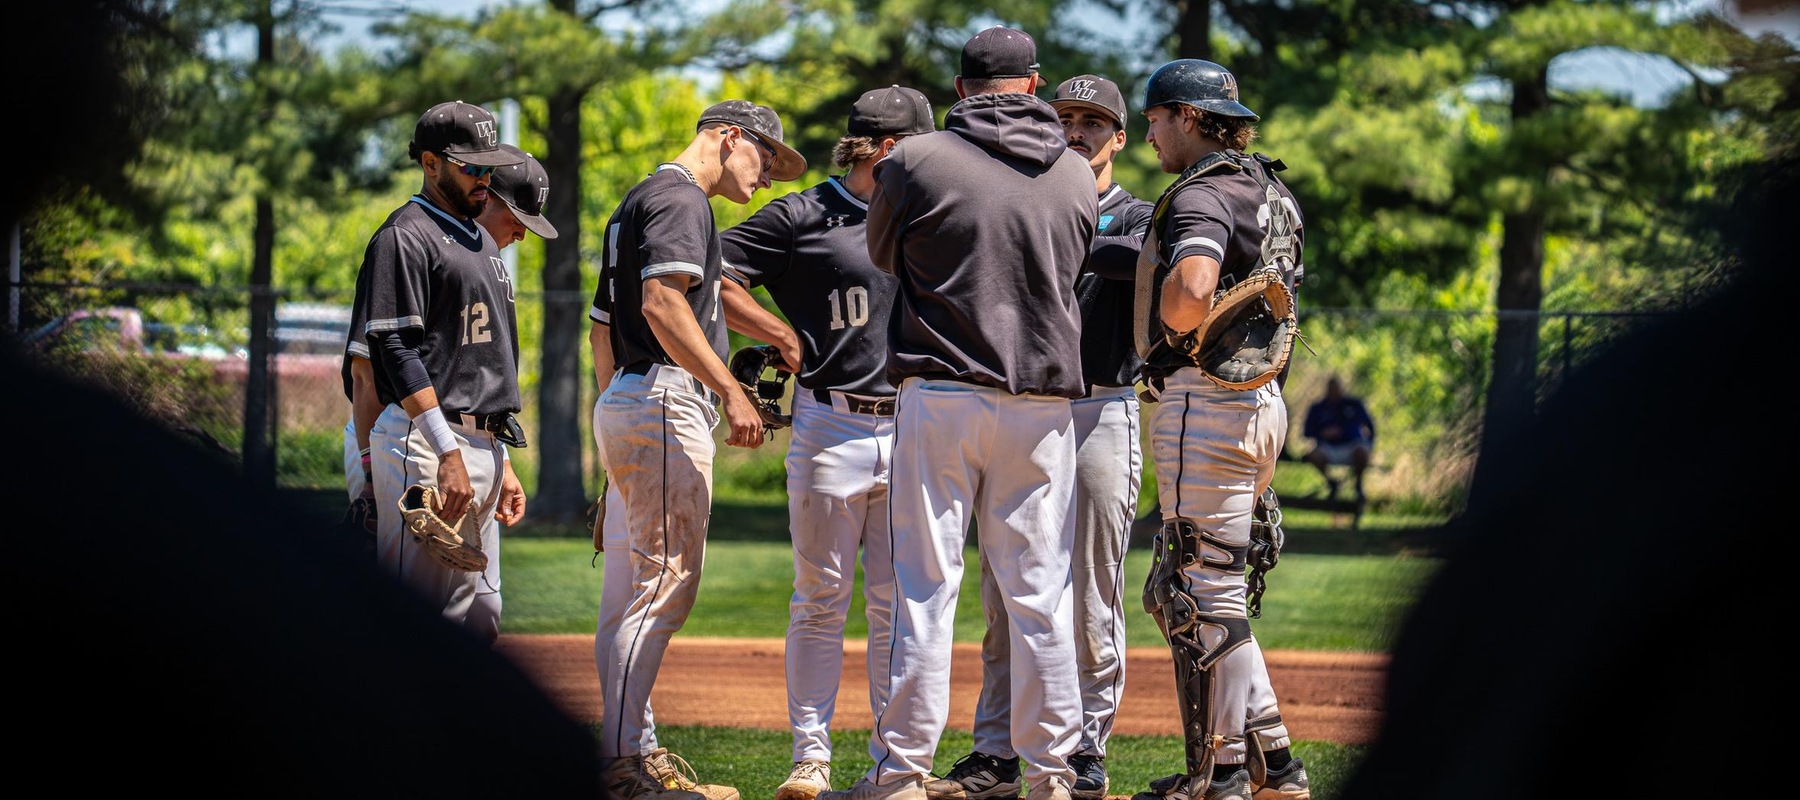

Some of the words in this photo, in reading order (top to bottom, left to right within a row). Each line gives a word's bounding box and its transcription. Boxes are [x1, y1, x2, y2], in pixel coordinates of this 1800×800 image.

[1069, 79, 1098, 101] WU
[475, 120, 498, 147] WU
[460, 302, 492, 346] 12
[828, 286, 869, 330] 10
